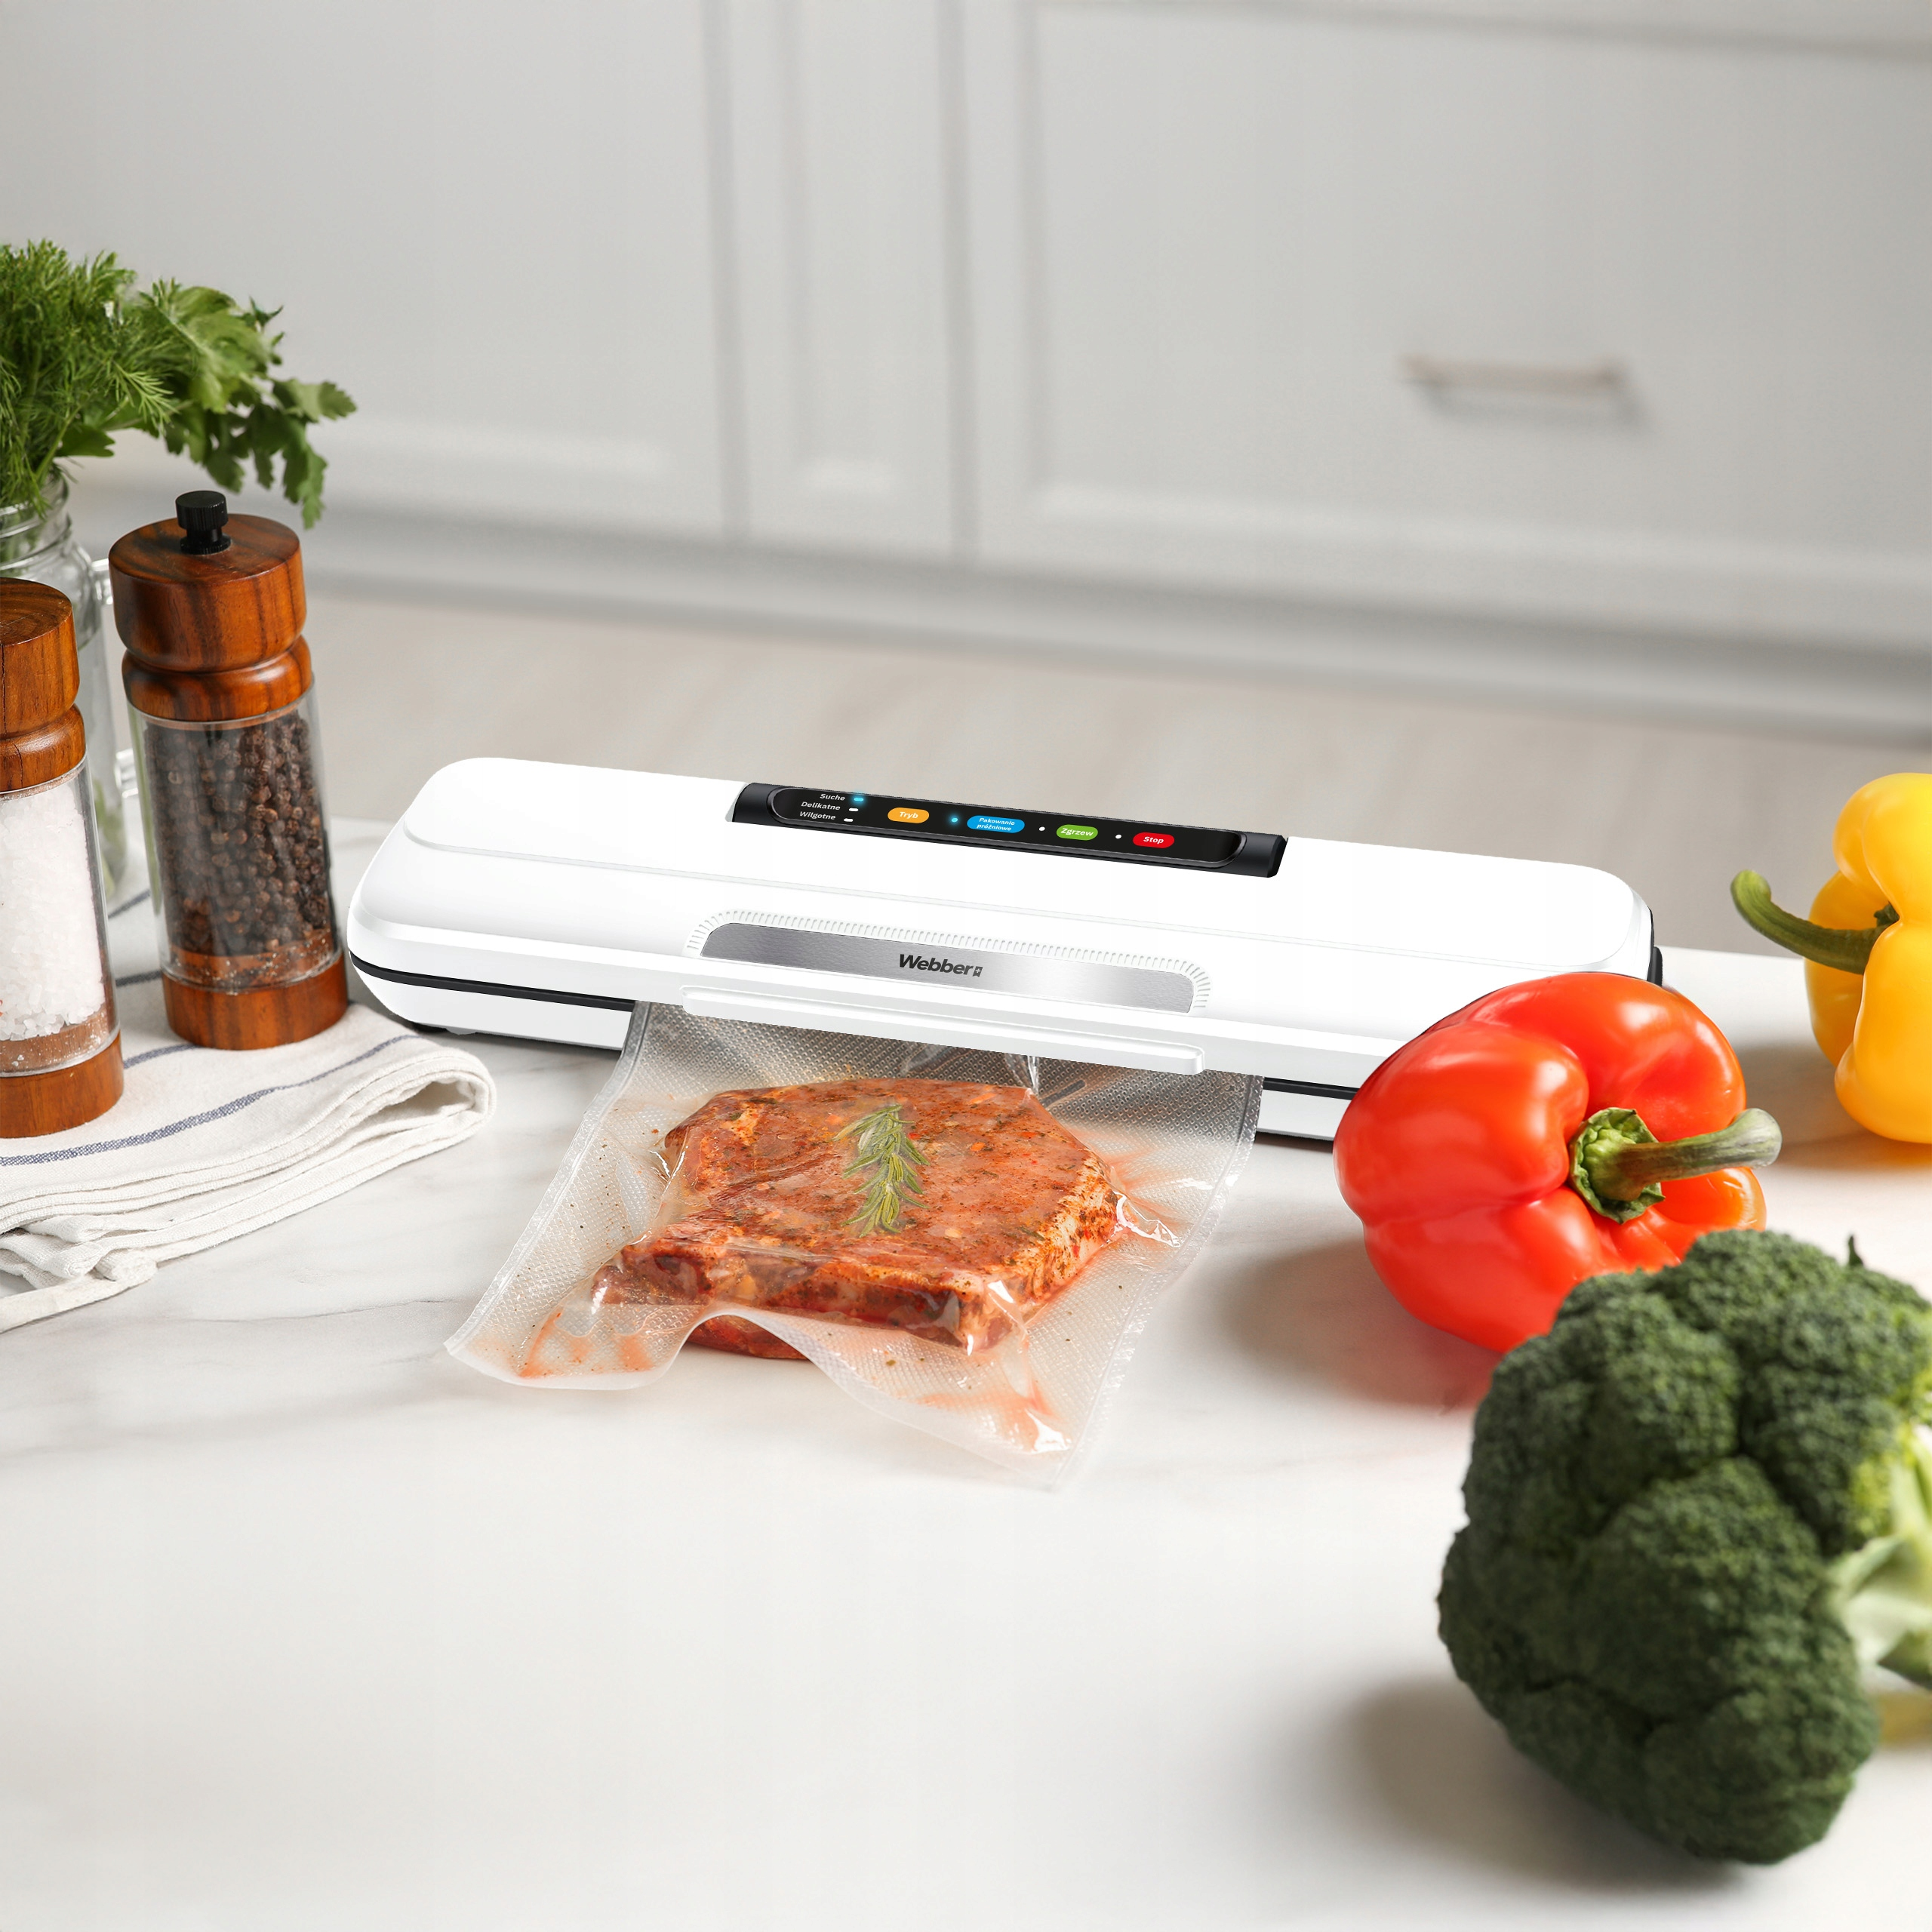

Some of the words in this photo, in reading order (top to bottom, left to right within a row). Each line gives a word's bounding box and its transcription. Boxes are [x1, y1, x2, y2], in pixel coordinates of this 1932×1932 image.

[801, 801, 841, 811] Delikatne
[800, 811, 836, 820] Wilgotne
[979, 817, 1016, 826] Pakowanie
[1060, 828, 1094, 836] Zgrzew
[1143, 836, 1164, 844] Stop
[899, 954, 974, 975] Webber
